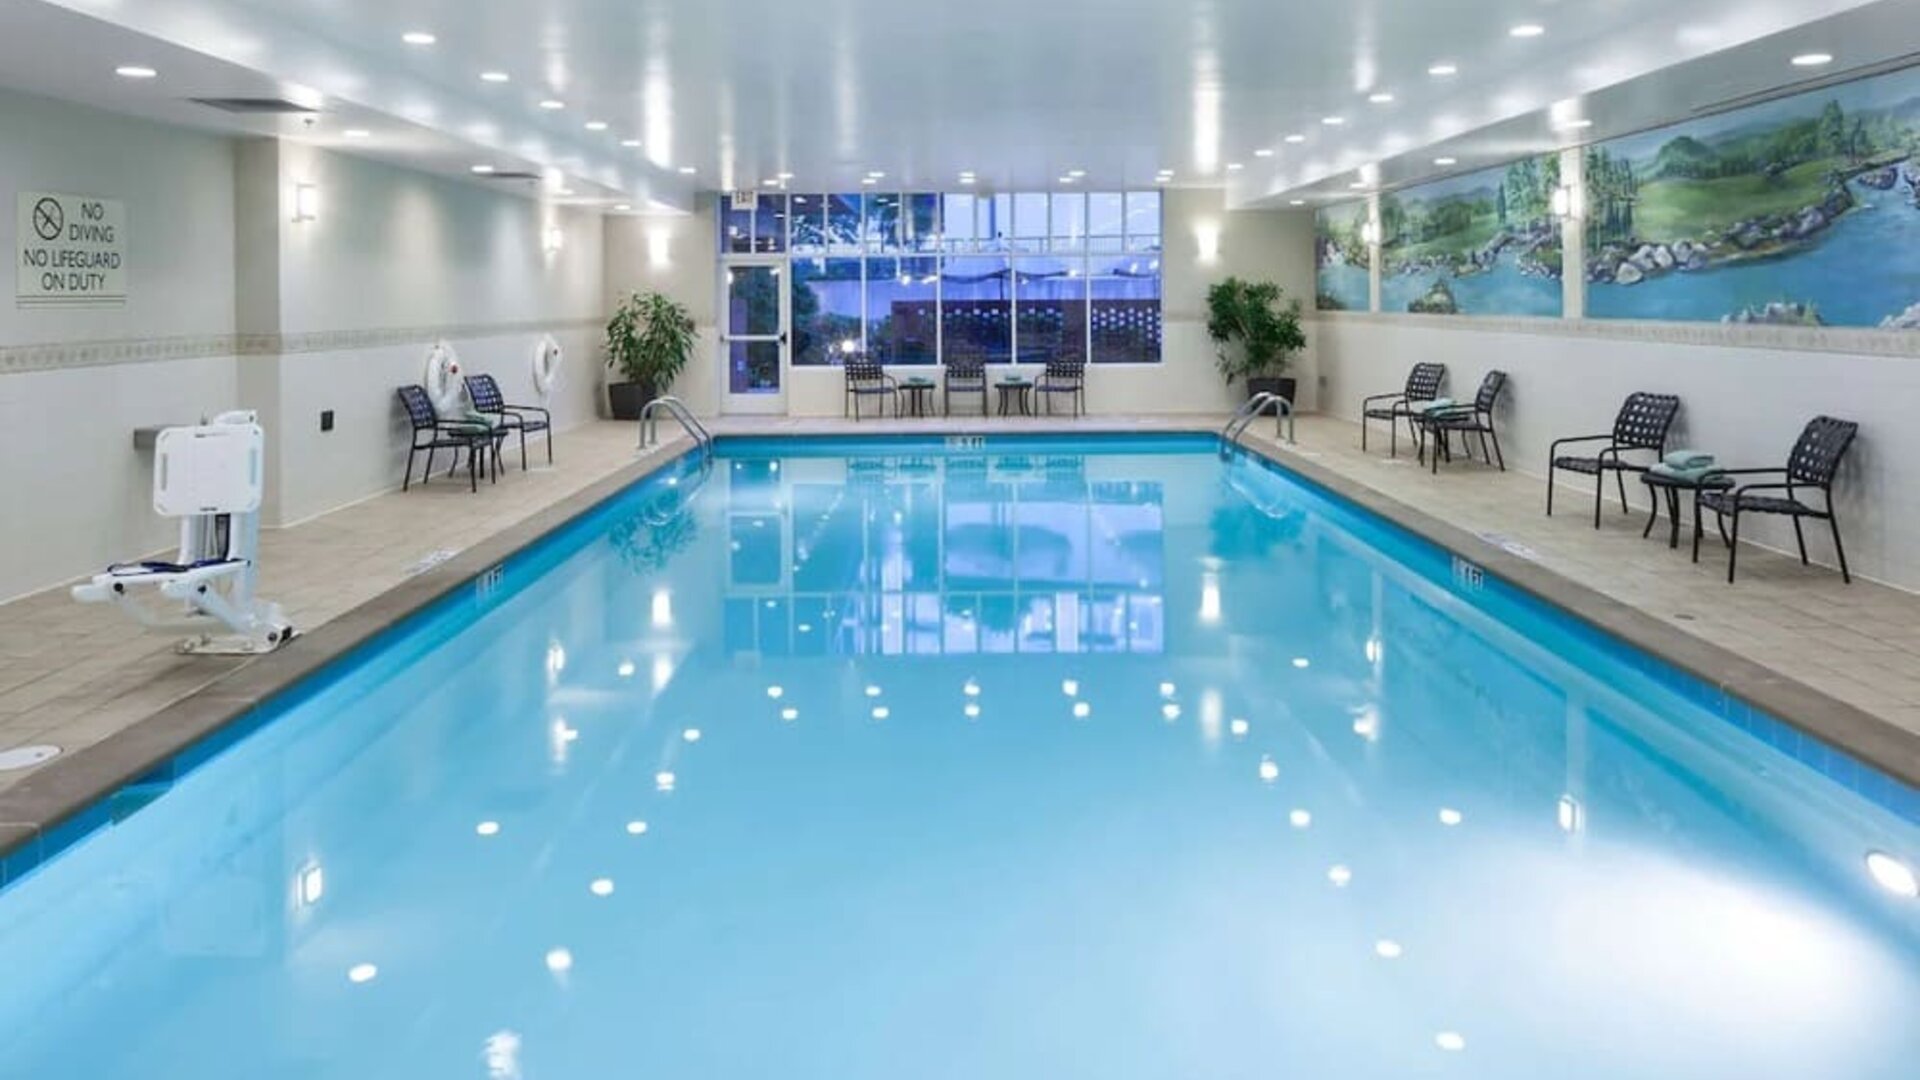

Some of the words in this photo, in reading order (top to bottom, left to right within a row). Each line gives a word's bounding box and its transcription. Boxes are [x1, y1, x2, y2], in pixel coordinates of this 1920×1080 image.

[81, 202, 104, 221] NO
[69, 224, 114, 243] DIVING
[23, 248, 48, 267] NO
[52, 250, 121, 269] LIFEGUARD
[41, 272, 64, 291] ON
[69, 273, 105, 291] DUTY
